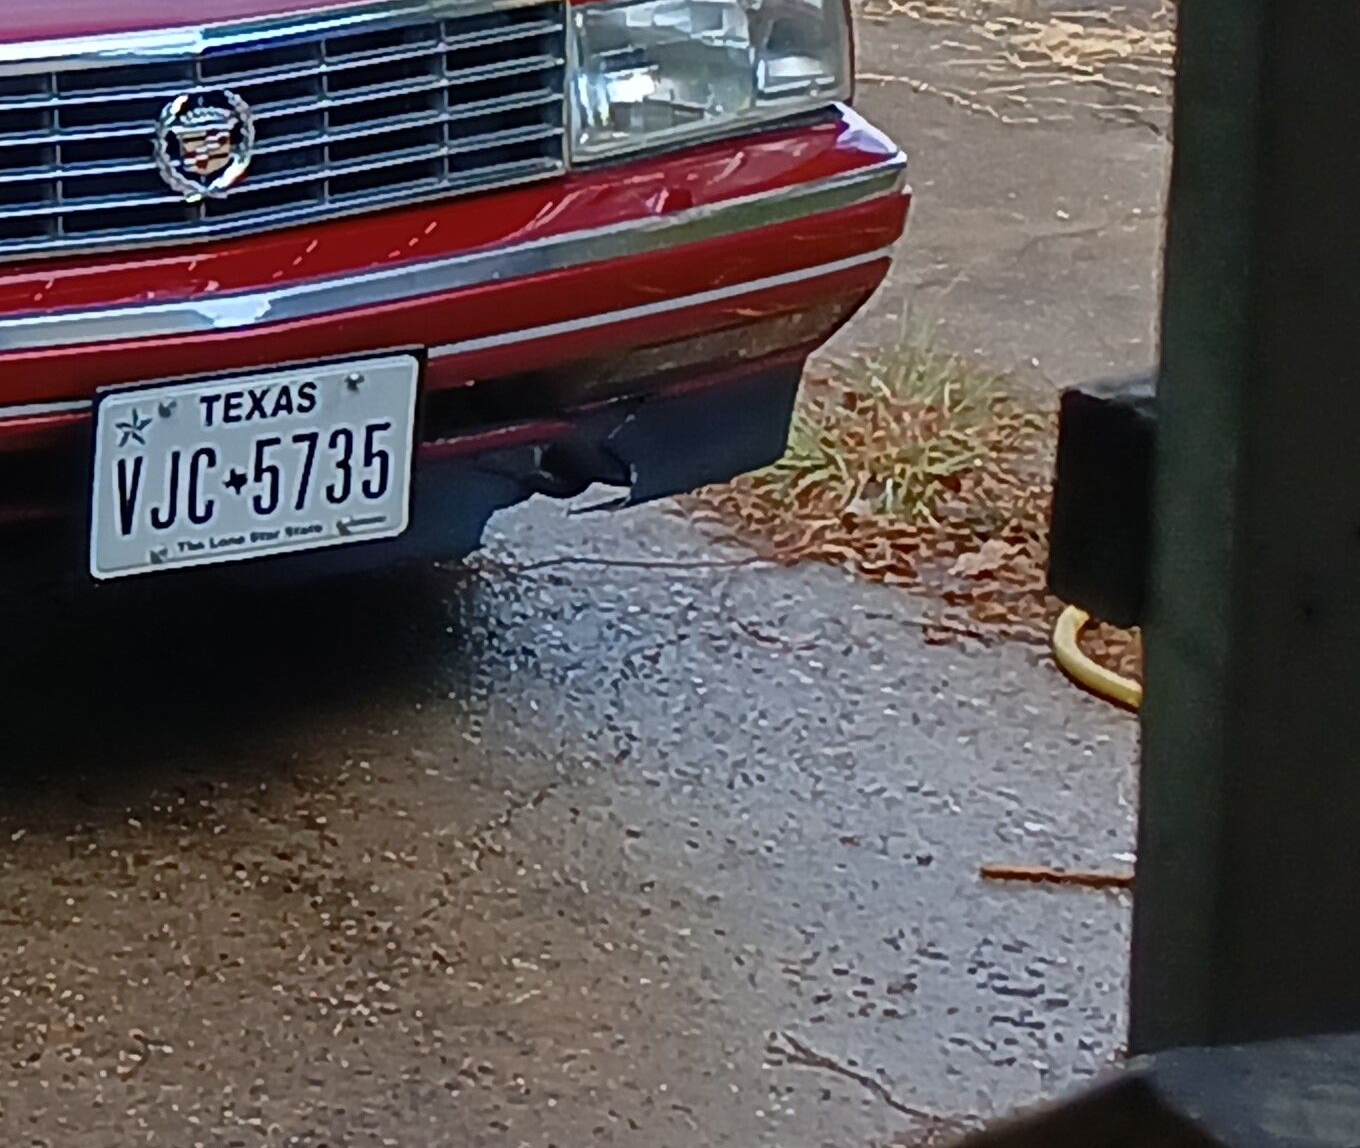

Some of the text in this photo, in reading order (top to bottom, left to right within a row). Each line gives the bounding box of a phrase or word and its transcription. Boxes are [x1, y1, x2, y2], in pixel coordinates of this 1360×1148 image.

[199, 381, 317, 427] TEXAS
[117, 421, 392, 536] VJC 5735
[178, 541, 205, 552] The
[209, 536, 245, 549] Lone
